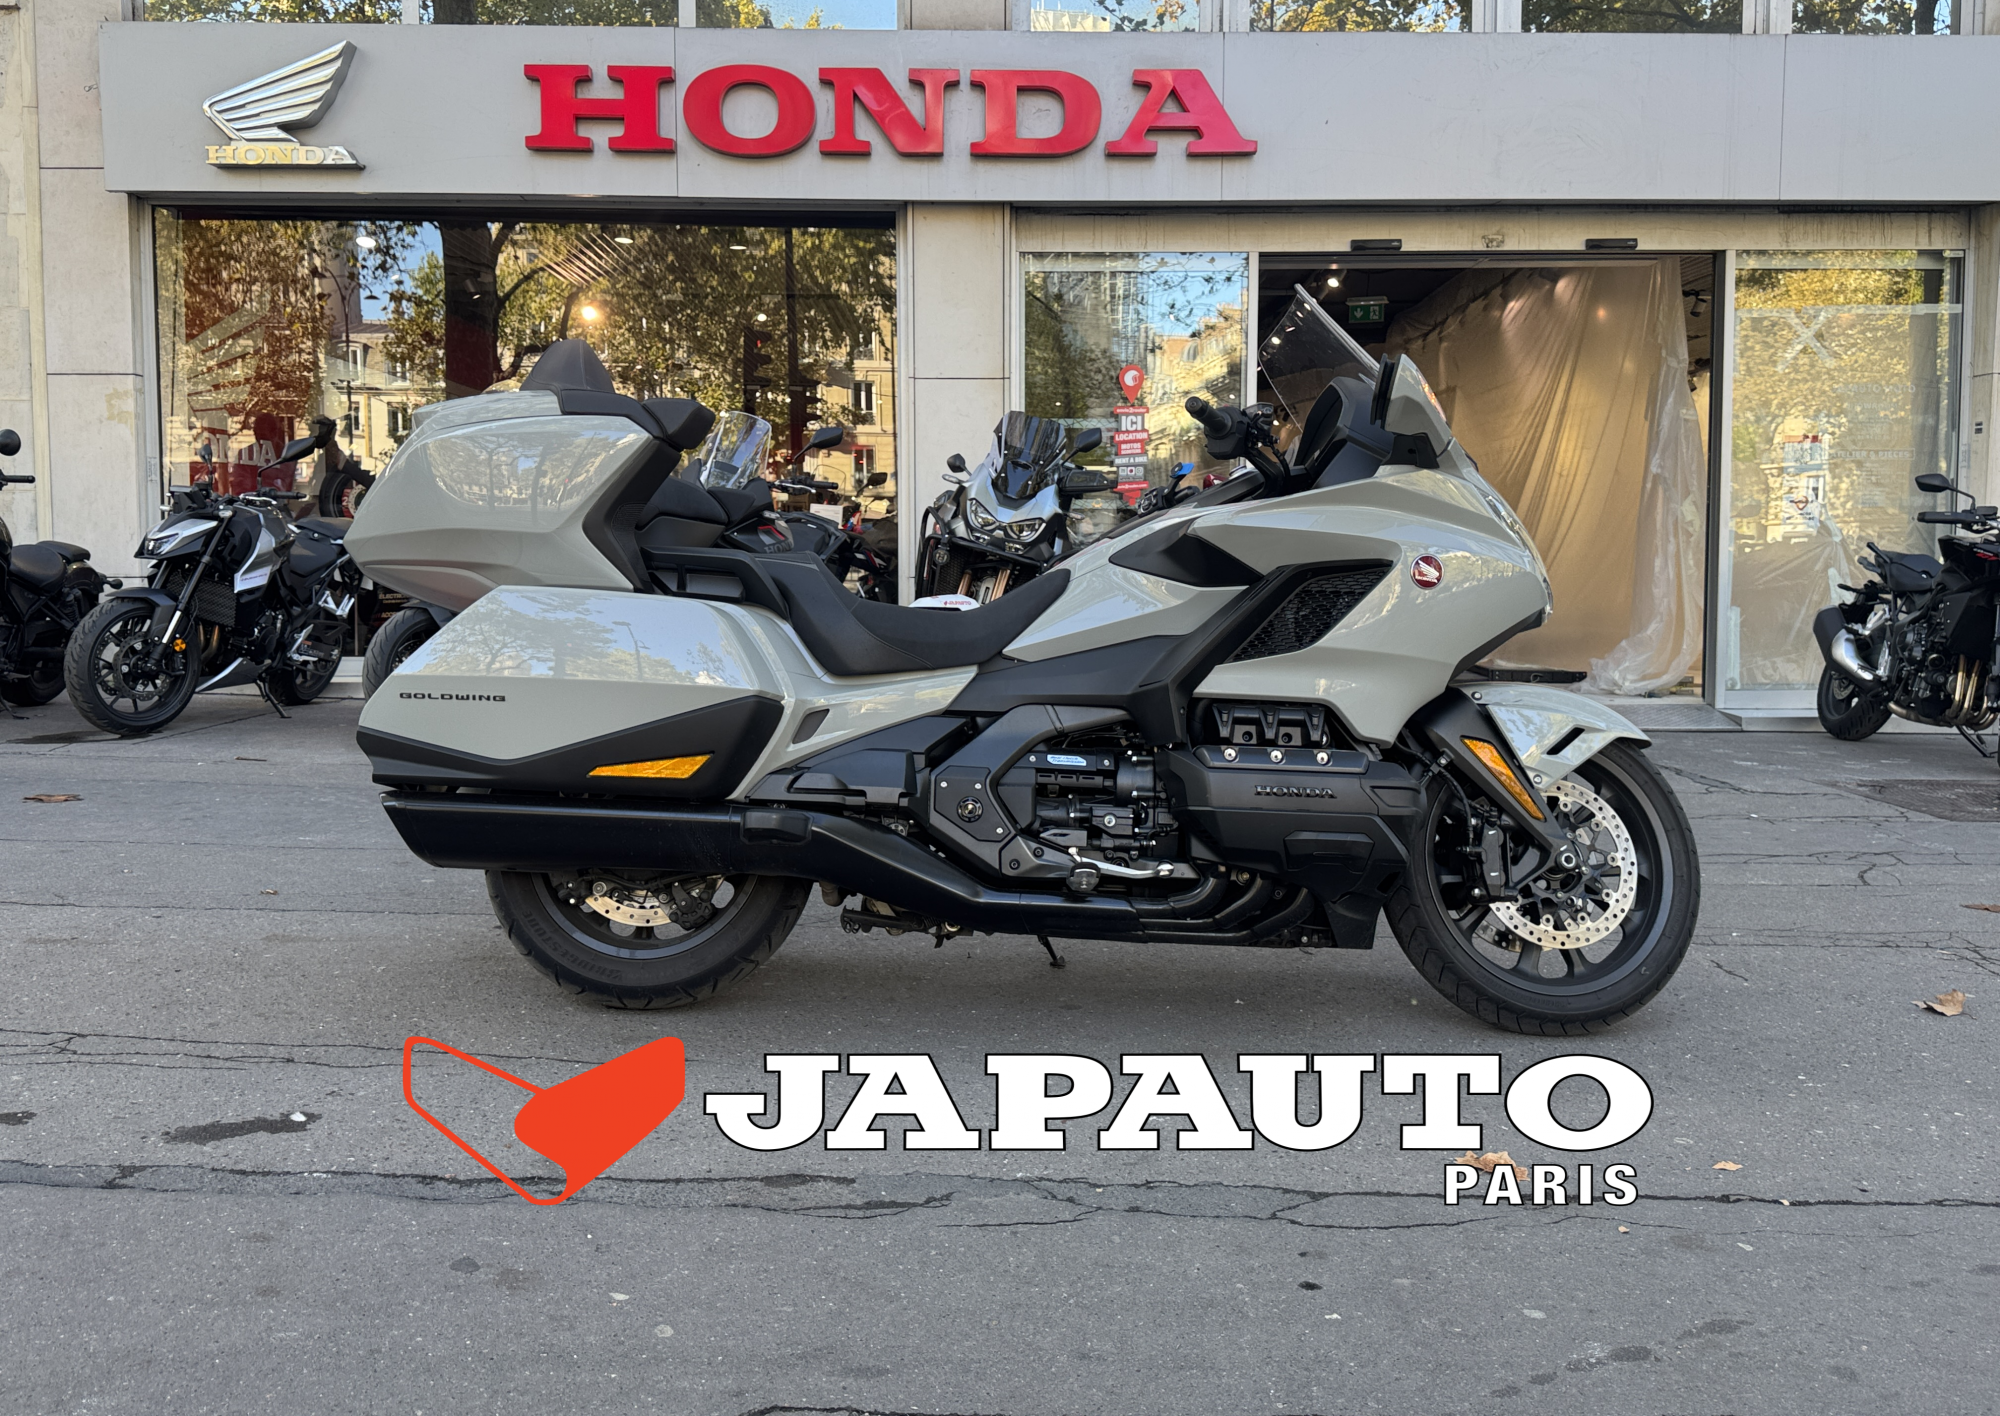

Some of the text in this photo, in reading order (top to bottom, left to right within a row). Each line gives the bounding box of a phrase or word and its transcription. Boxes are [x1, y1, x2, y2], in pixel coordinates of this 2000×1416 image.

[523, 64, 1258, 157] HONDA
[205, 145, 357, 165] HONDA
[1121, 415, 1142, 431] ICI
[1115, 432, 1148, 441] LOCATION
[193, 431, 281, 469] ONDA
[1121, 442, 1142, 450] MOTOS
[399, 692, 506, 702] GOLDWING
[1254, 785, 1338, 799] HONDA
